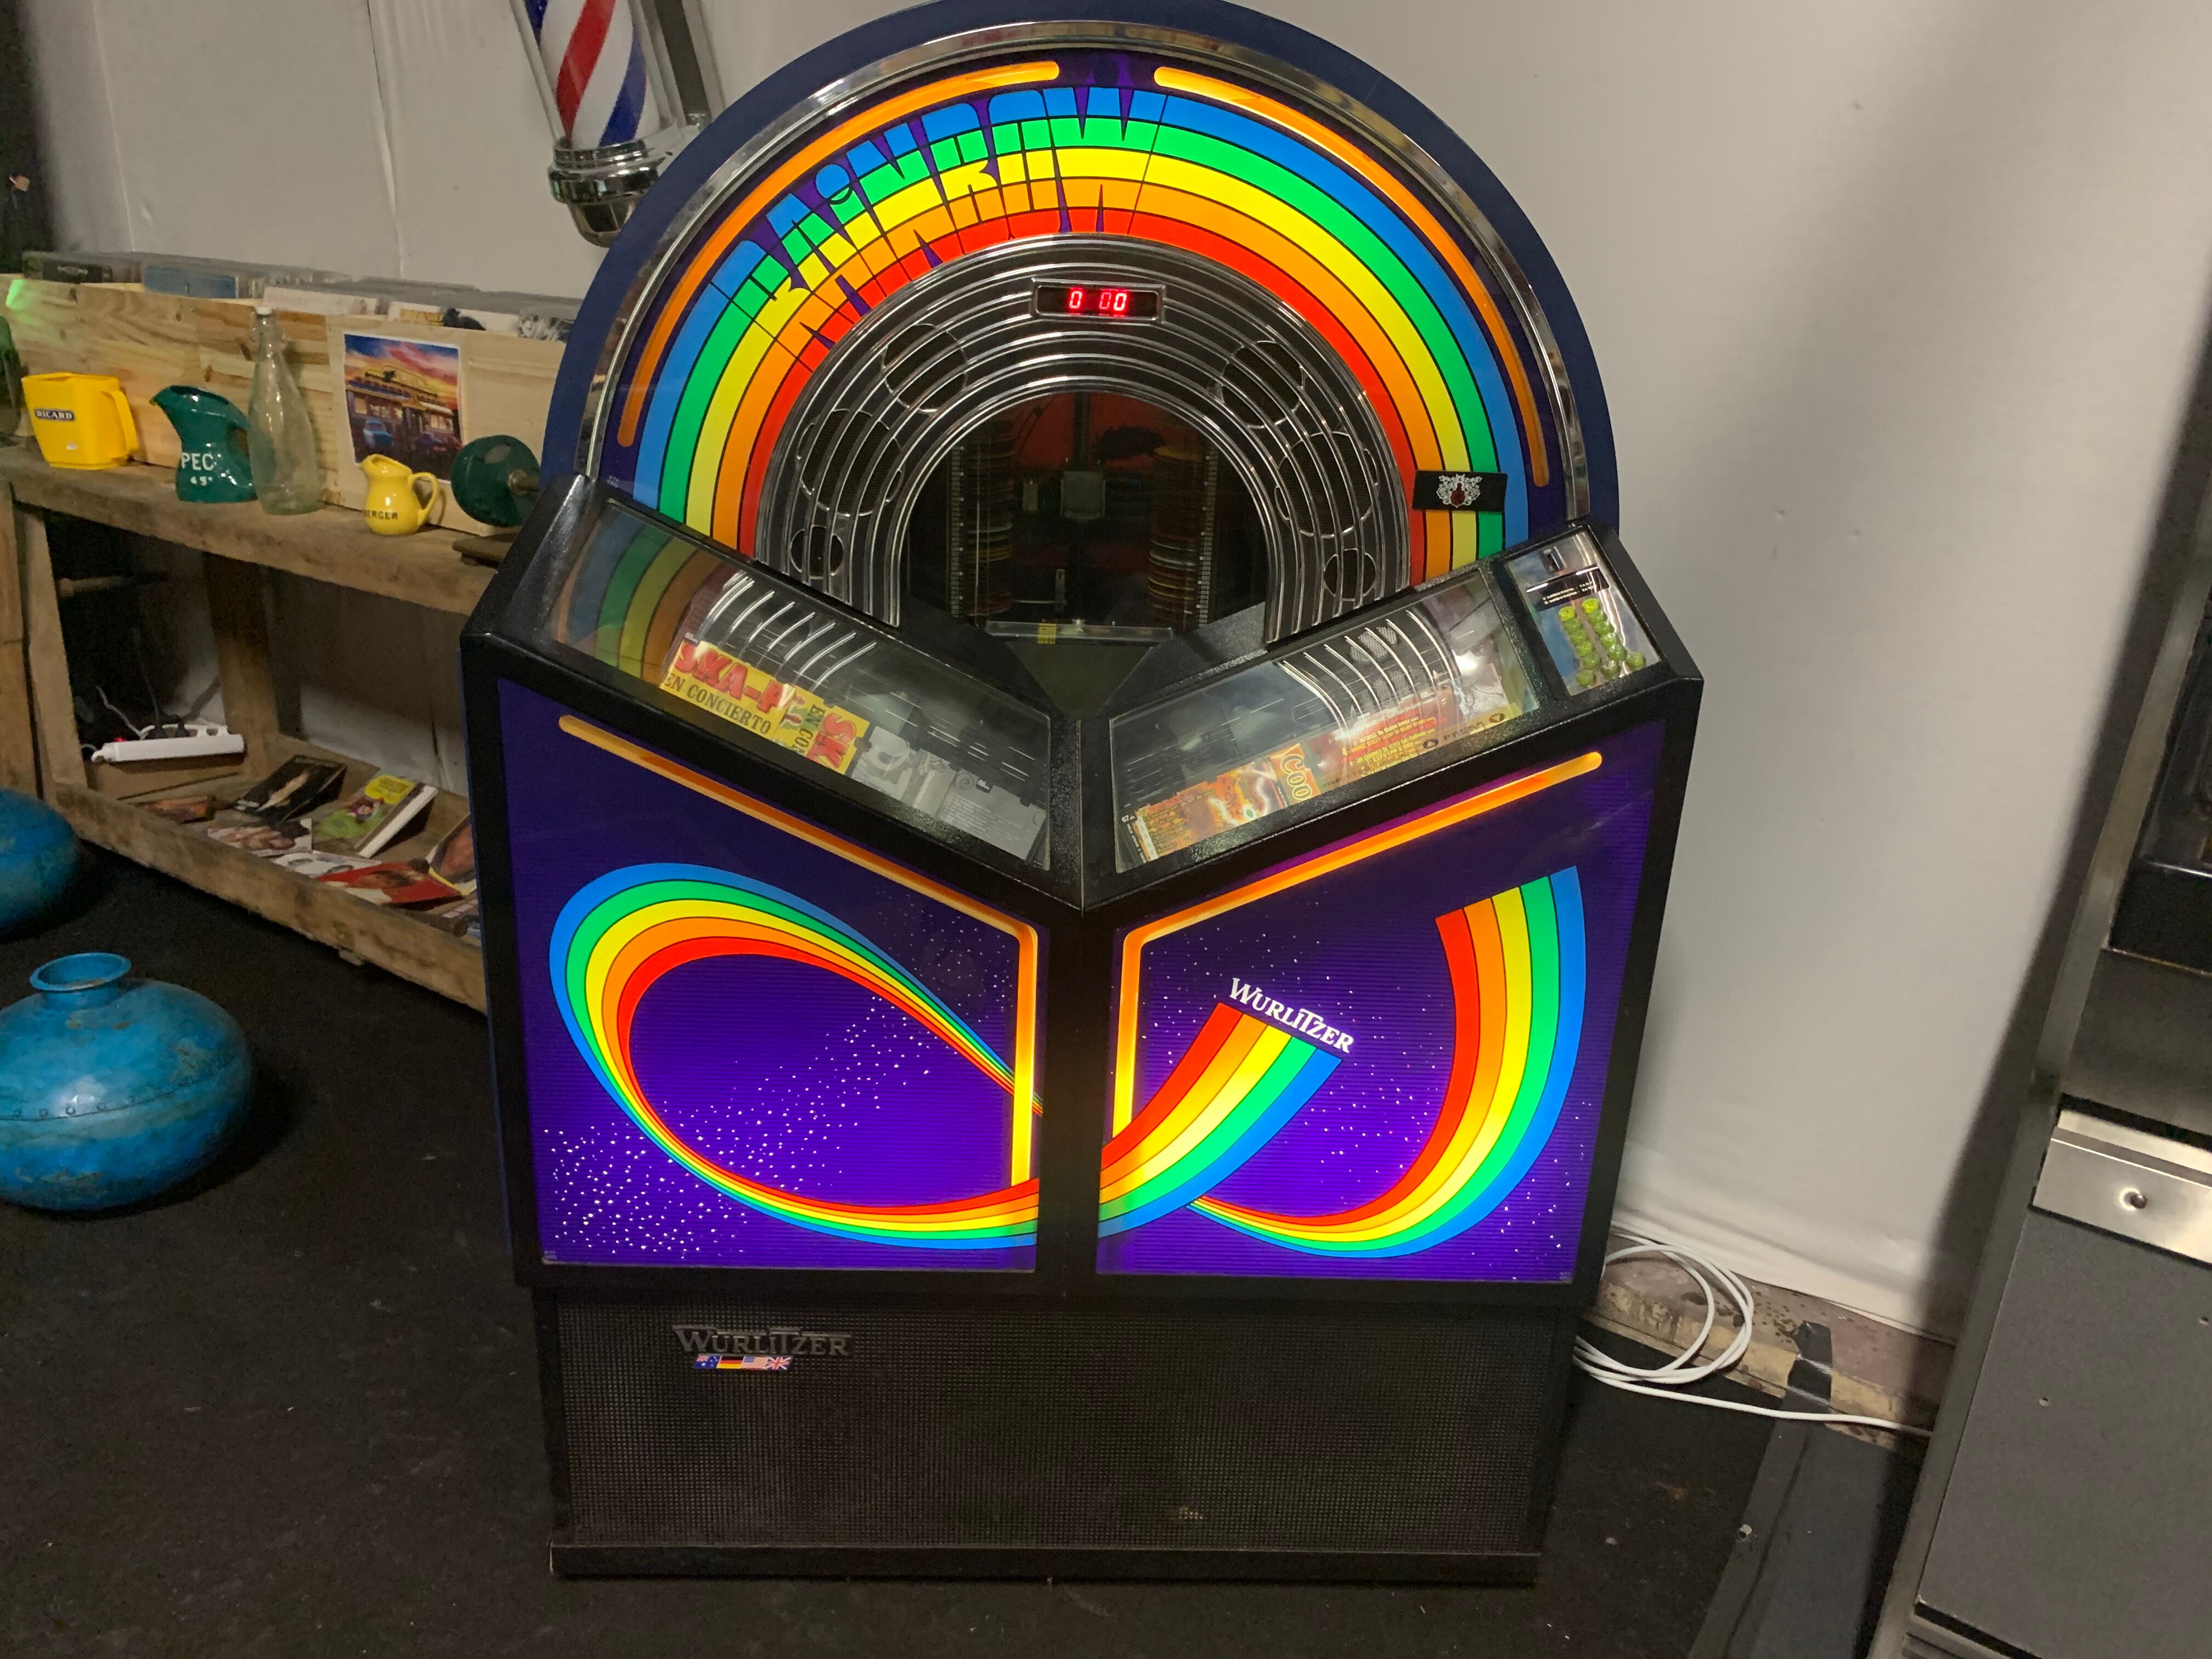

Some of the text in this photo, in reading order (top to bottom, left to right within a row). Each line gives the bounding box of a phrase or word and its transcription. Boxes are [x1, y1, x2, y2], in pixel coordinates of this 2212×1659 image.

[36, 410, 73, 420] RICARD
[181, 452, 215, 471] PEC
[664, 673, 771, 735] EN CONCIERTO
[805, 704, 826, 727] EN
[1229, 977, 1354, 1053] WURLITZER
[672, 1324, 851, 1356] WURLITZER
